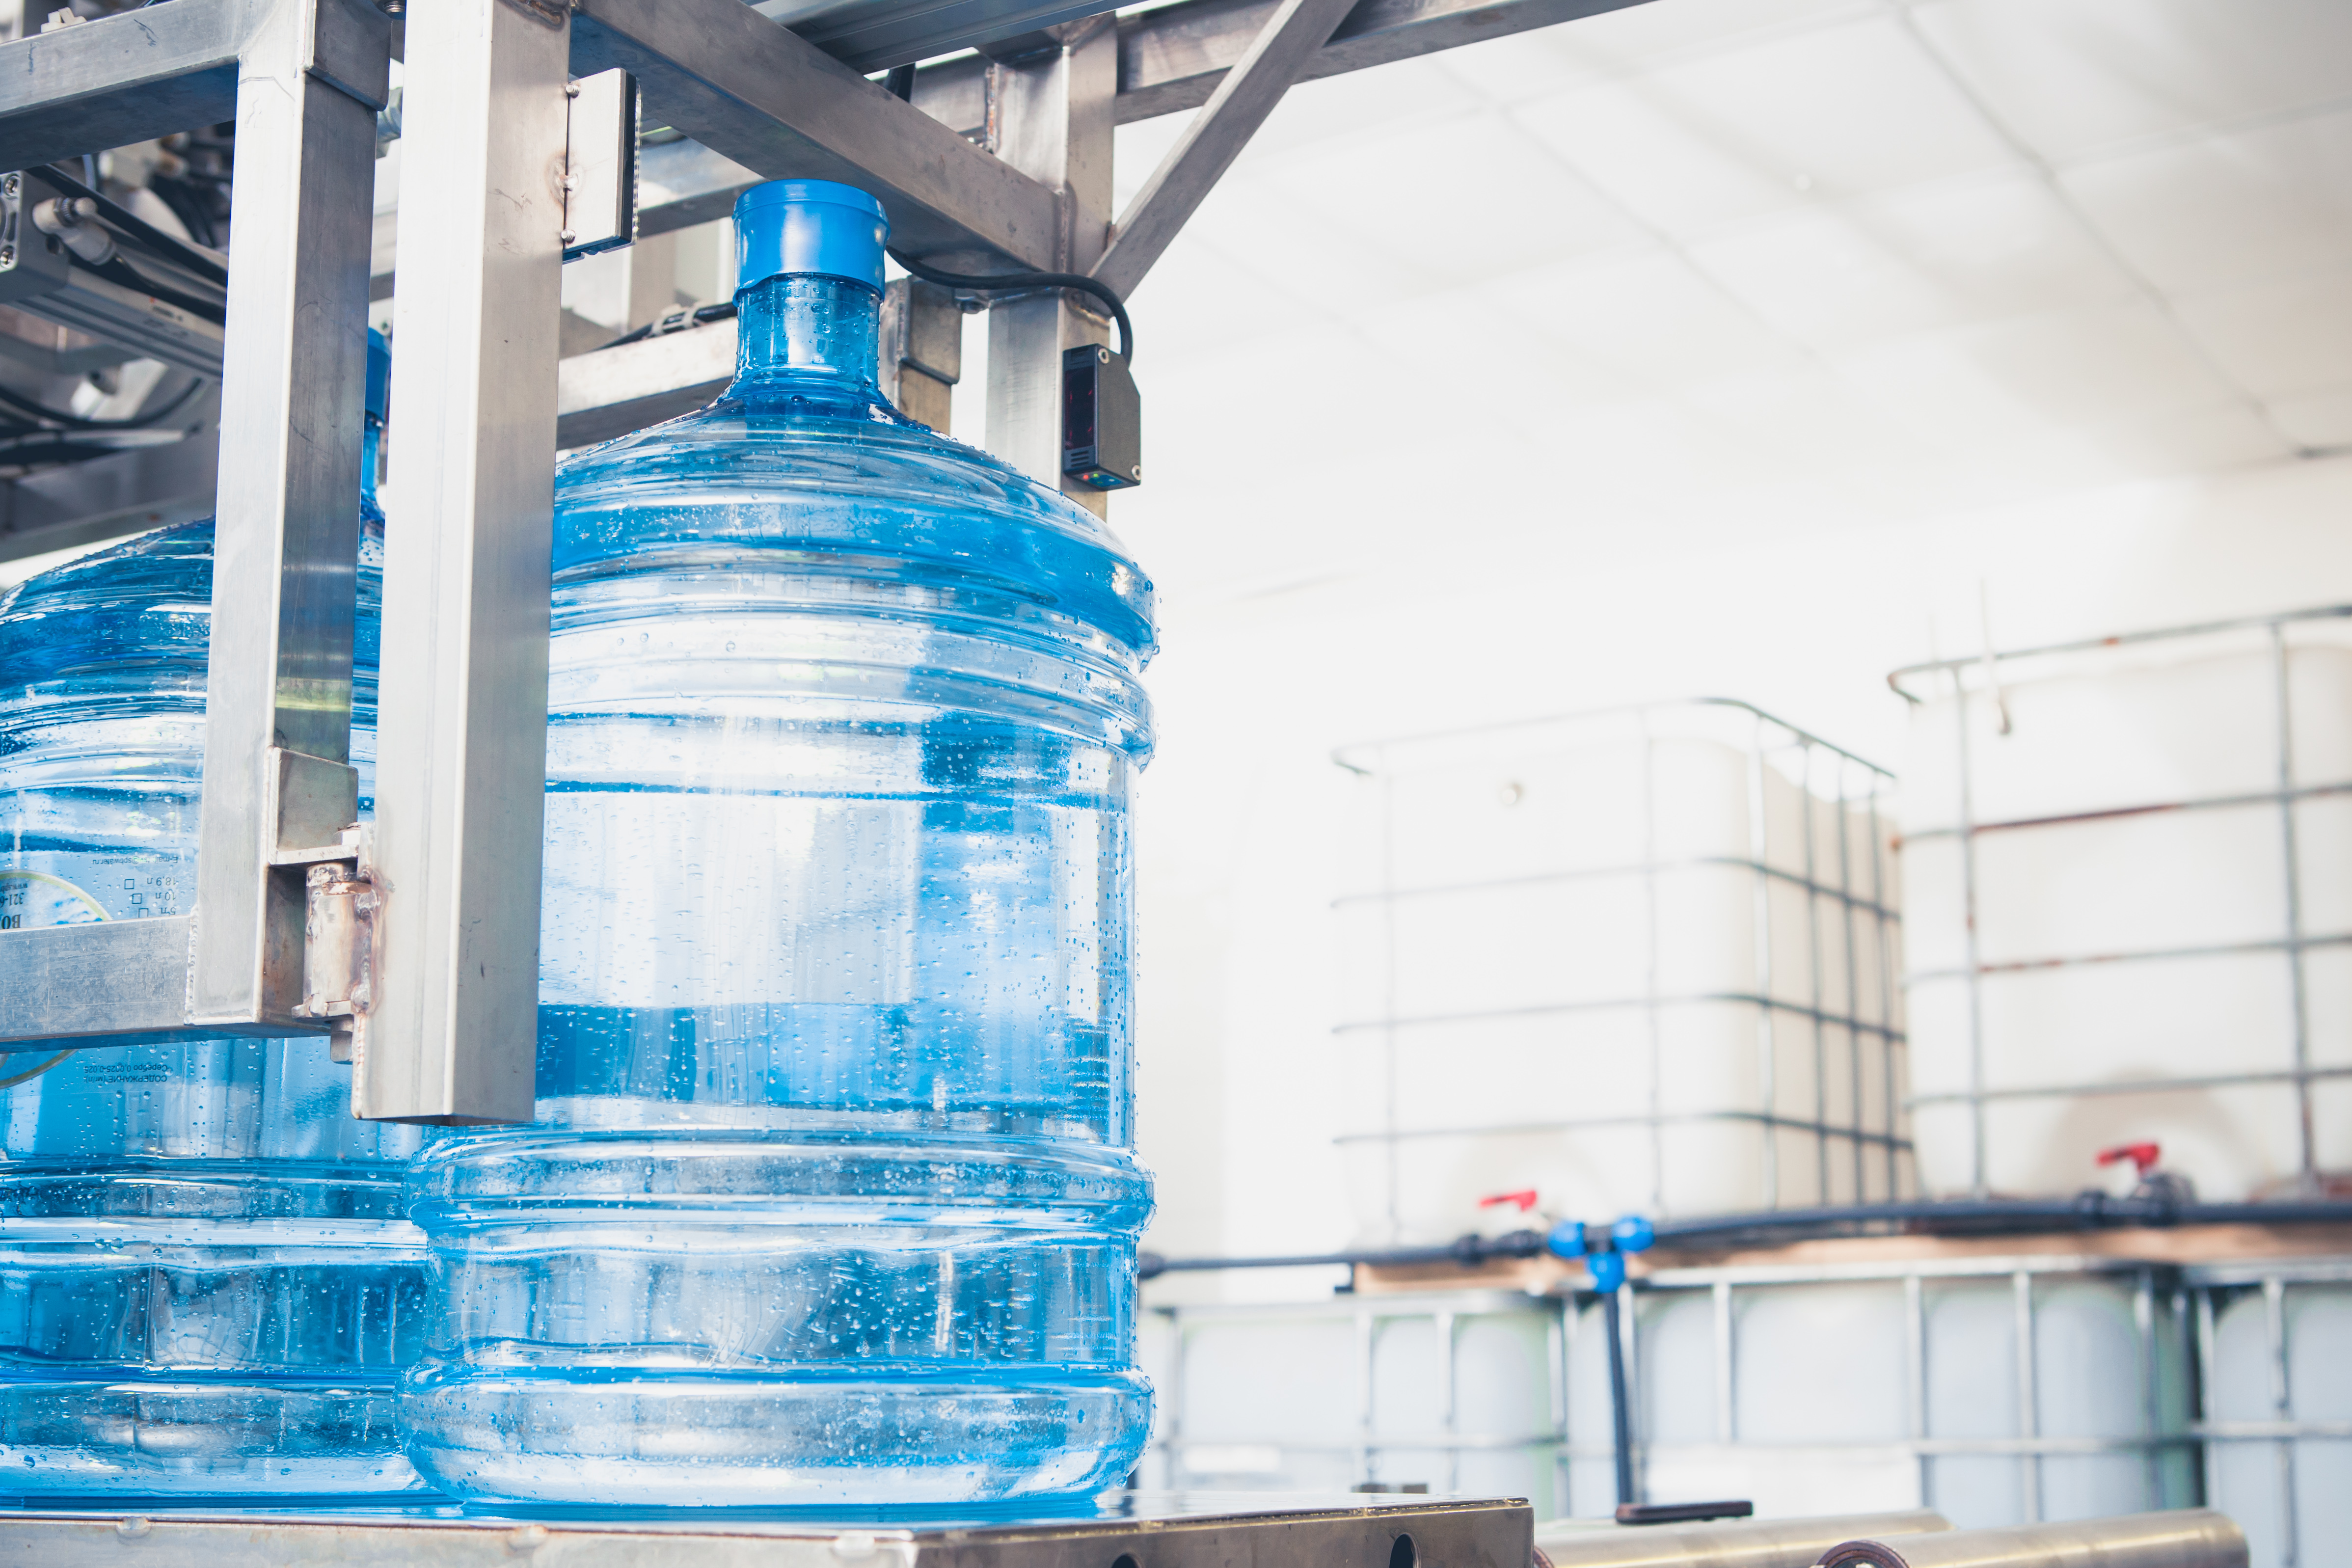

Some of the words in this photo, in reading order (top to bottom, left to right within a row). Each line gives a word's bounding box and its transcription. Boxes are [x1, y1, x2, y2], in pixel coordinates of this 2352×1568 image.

[156, 876, 175, 886] 18,9
[165, 892, 175, 900] 10
[133, 1063, 167, 1072] Серебро
